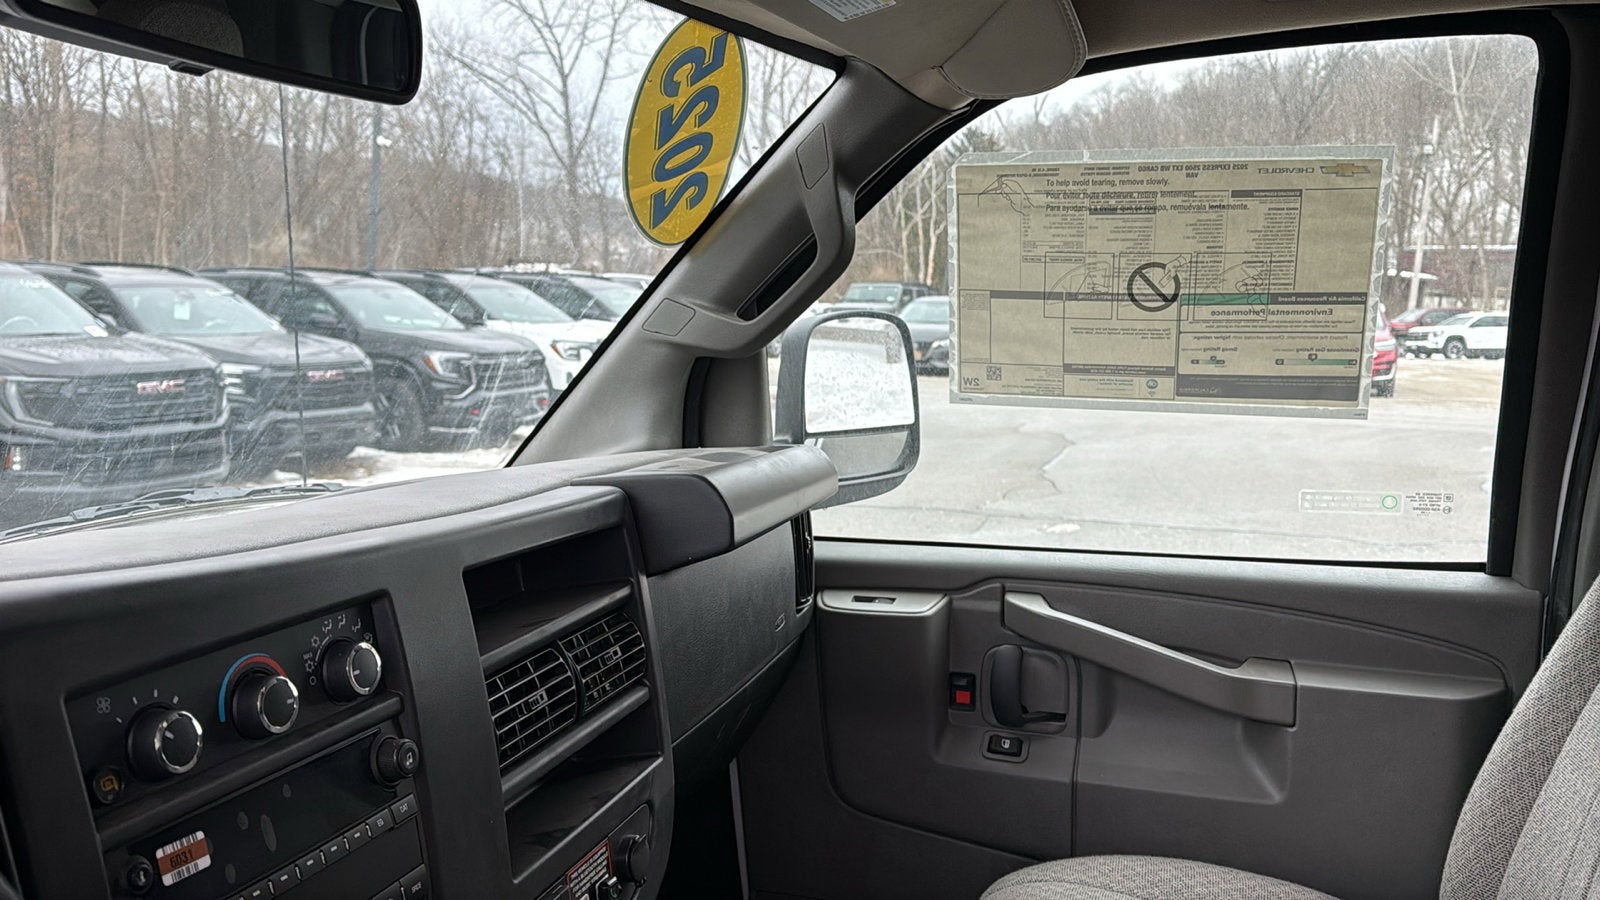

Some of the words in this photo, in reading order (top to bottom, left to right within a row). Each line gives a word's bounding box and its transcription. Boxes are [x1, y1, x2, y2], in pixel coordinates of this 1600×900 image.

[1046, 179, 1055, 187] To
[1055, 178, 1070, 188] help
[1071, 179, 1090, 187] avoid
[1091, 178, 1118, 188] tearing,
[1145, 177, 1170, 187] slowly.
[1045, 203, 1062, 211] Para
